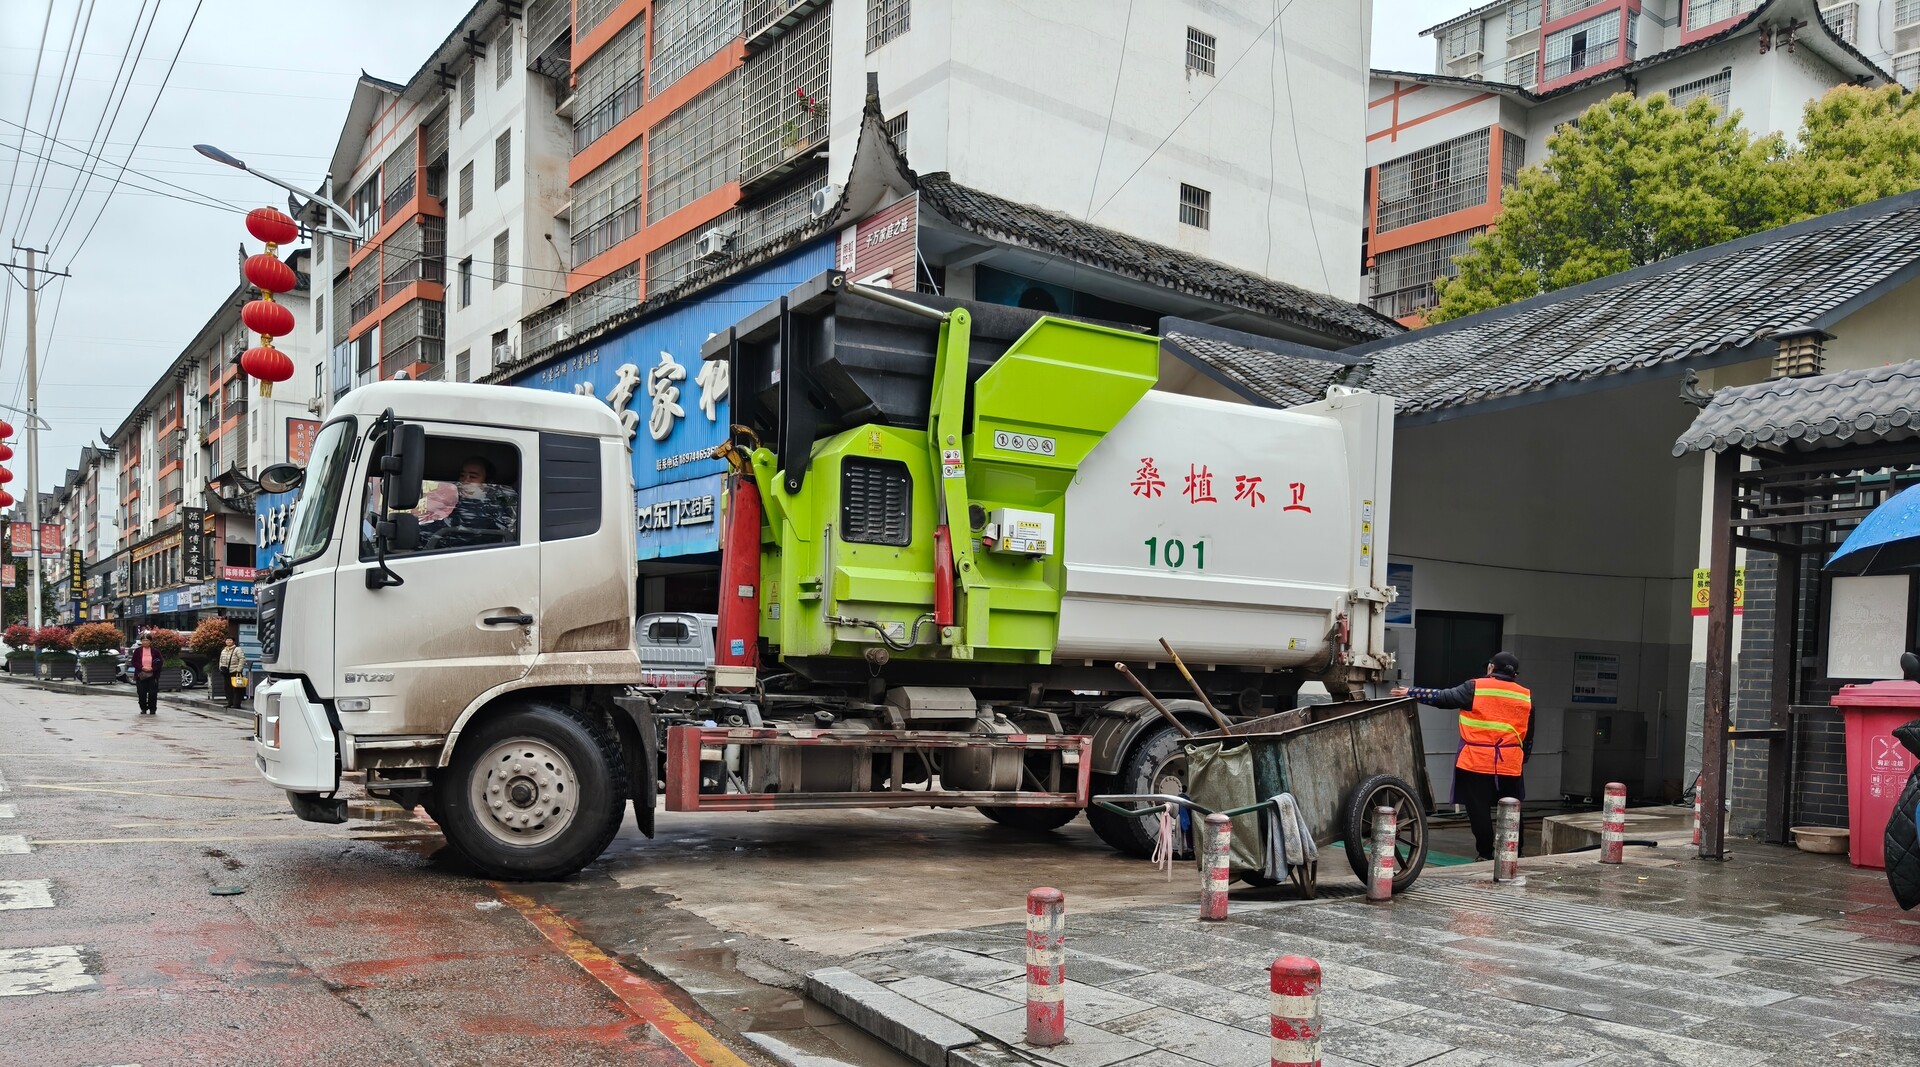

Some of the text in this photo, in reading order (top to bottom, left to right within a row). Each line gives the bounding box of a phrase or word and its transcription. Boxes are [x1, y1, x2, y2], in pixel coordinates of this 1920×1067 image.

[866, 216, 908, 249] 千万家庭之选
[1130, 457, 1312, 514] 桑植环卫
[653, 494, 713, 529] 东门大药房
[187, 512, 201, 576] 陈师傅土菜馆
[1144, 536, 1205, 570] 101
